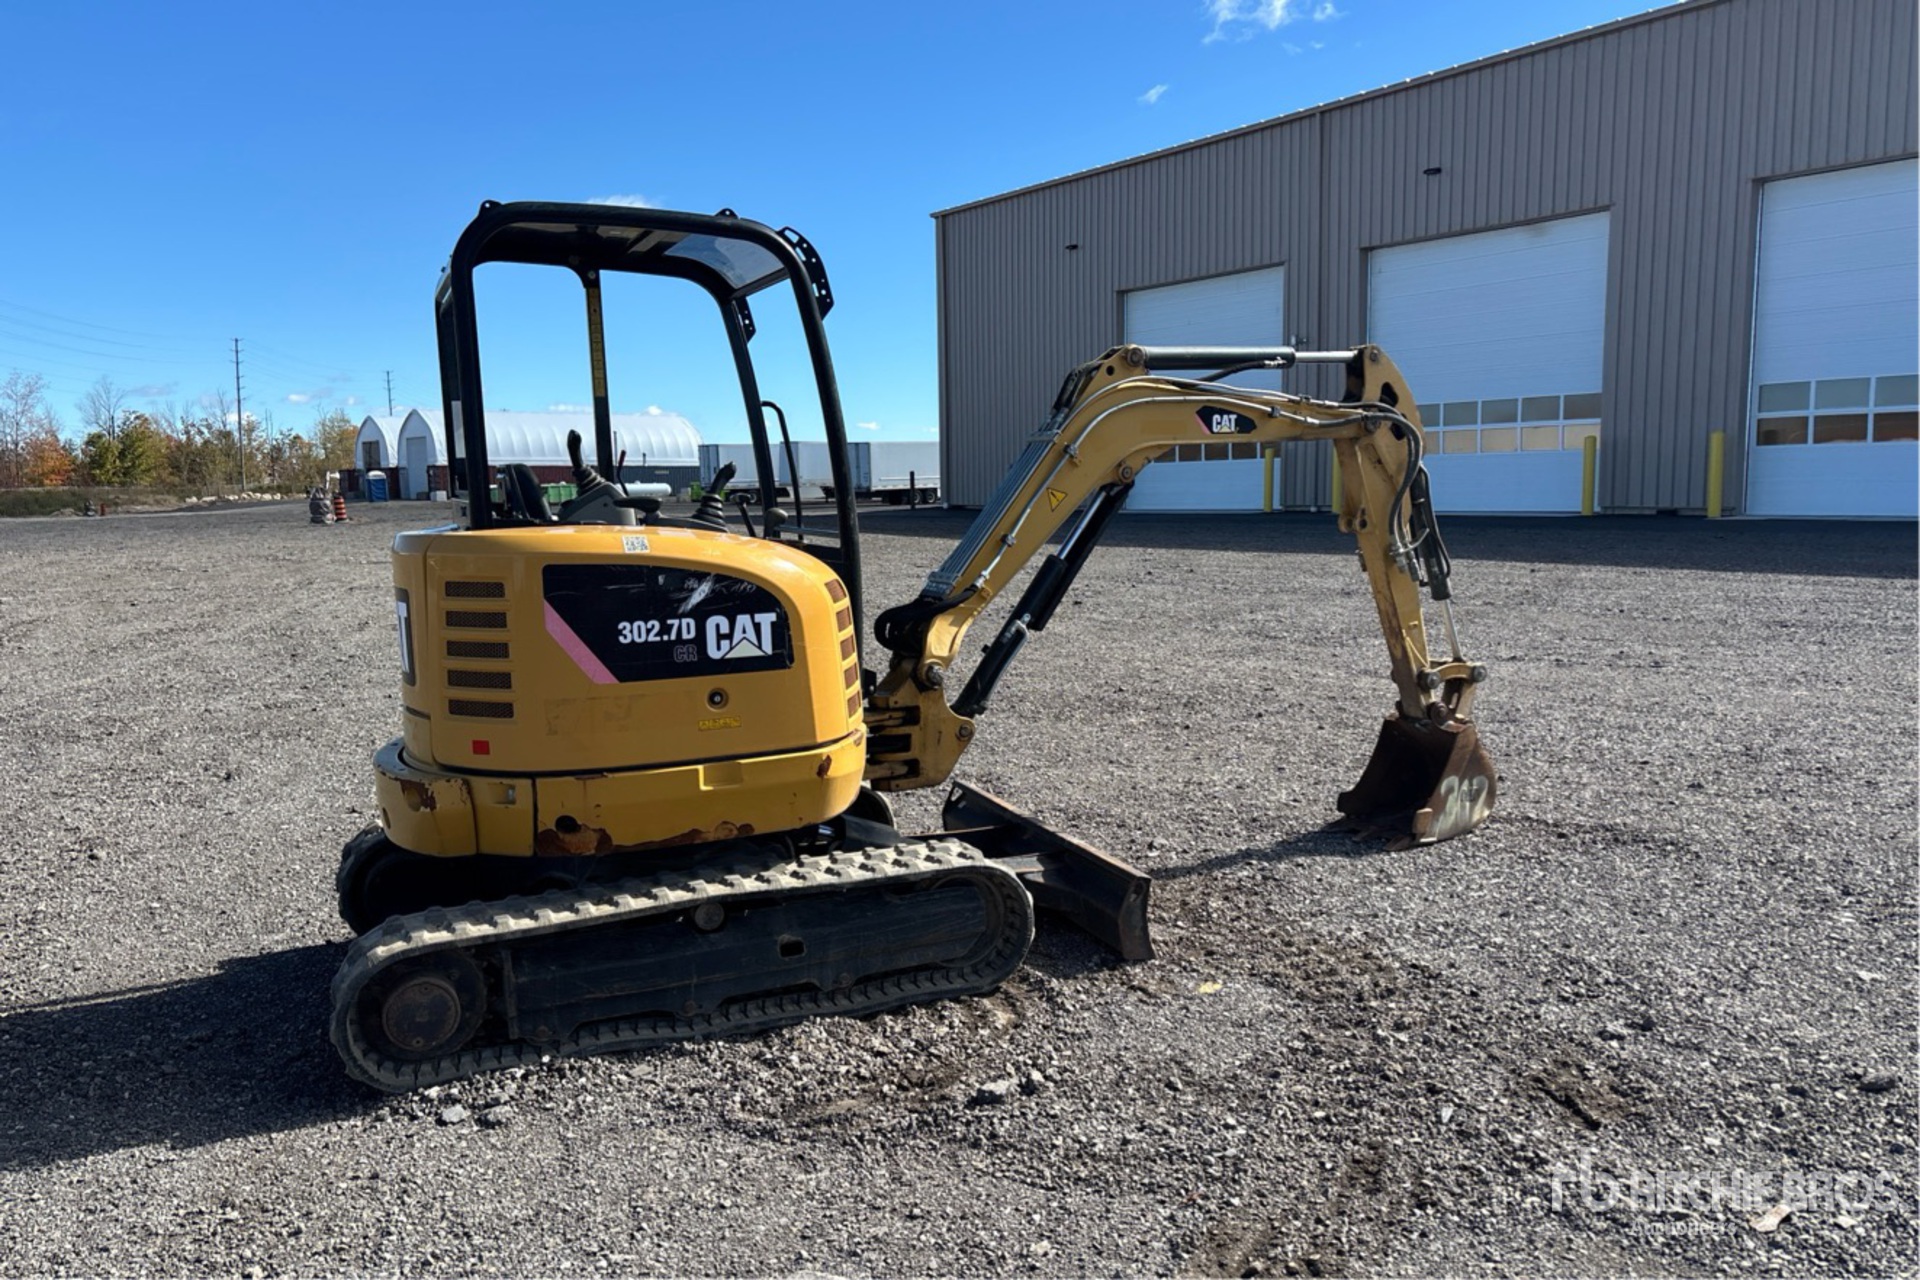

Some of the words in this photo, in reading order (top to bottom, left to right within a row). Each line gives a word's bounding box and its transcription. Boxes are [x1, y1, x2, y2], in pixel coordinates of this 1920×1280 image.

[1212, 414, 1237, 433] CAT
[617, 617, 696, 644] 302.7D
[705, 612, 777, 660] CAT
[673, 645, 698, 662] CR
